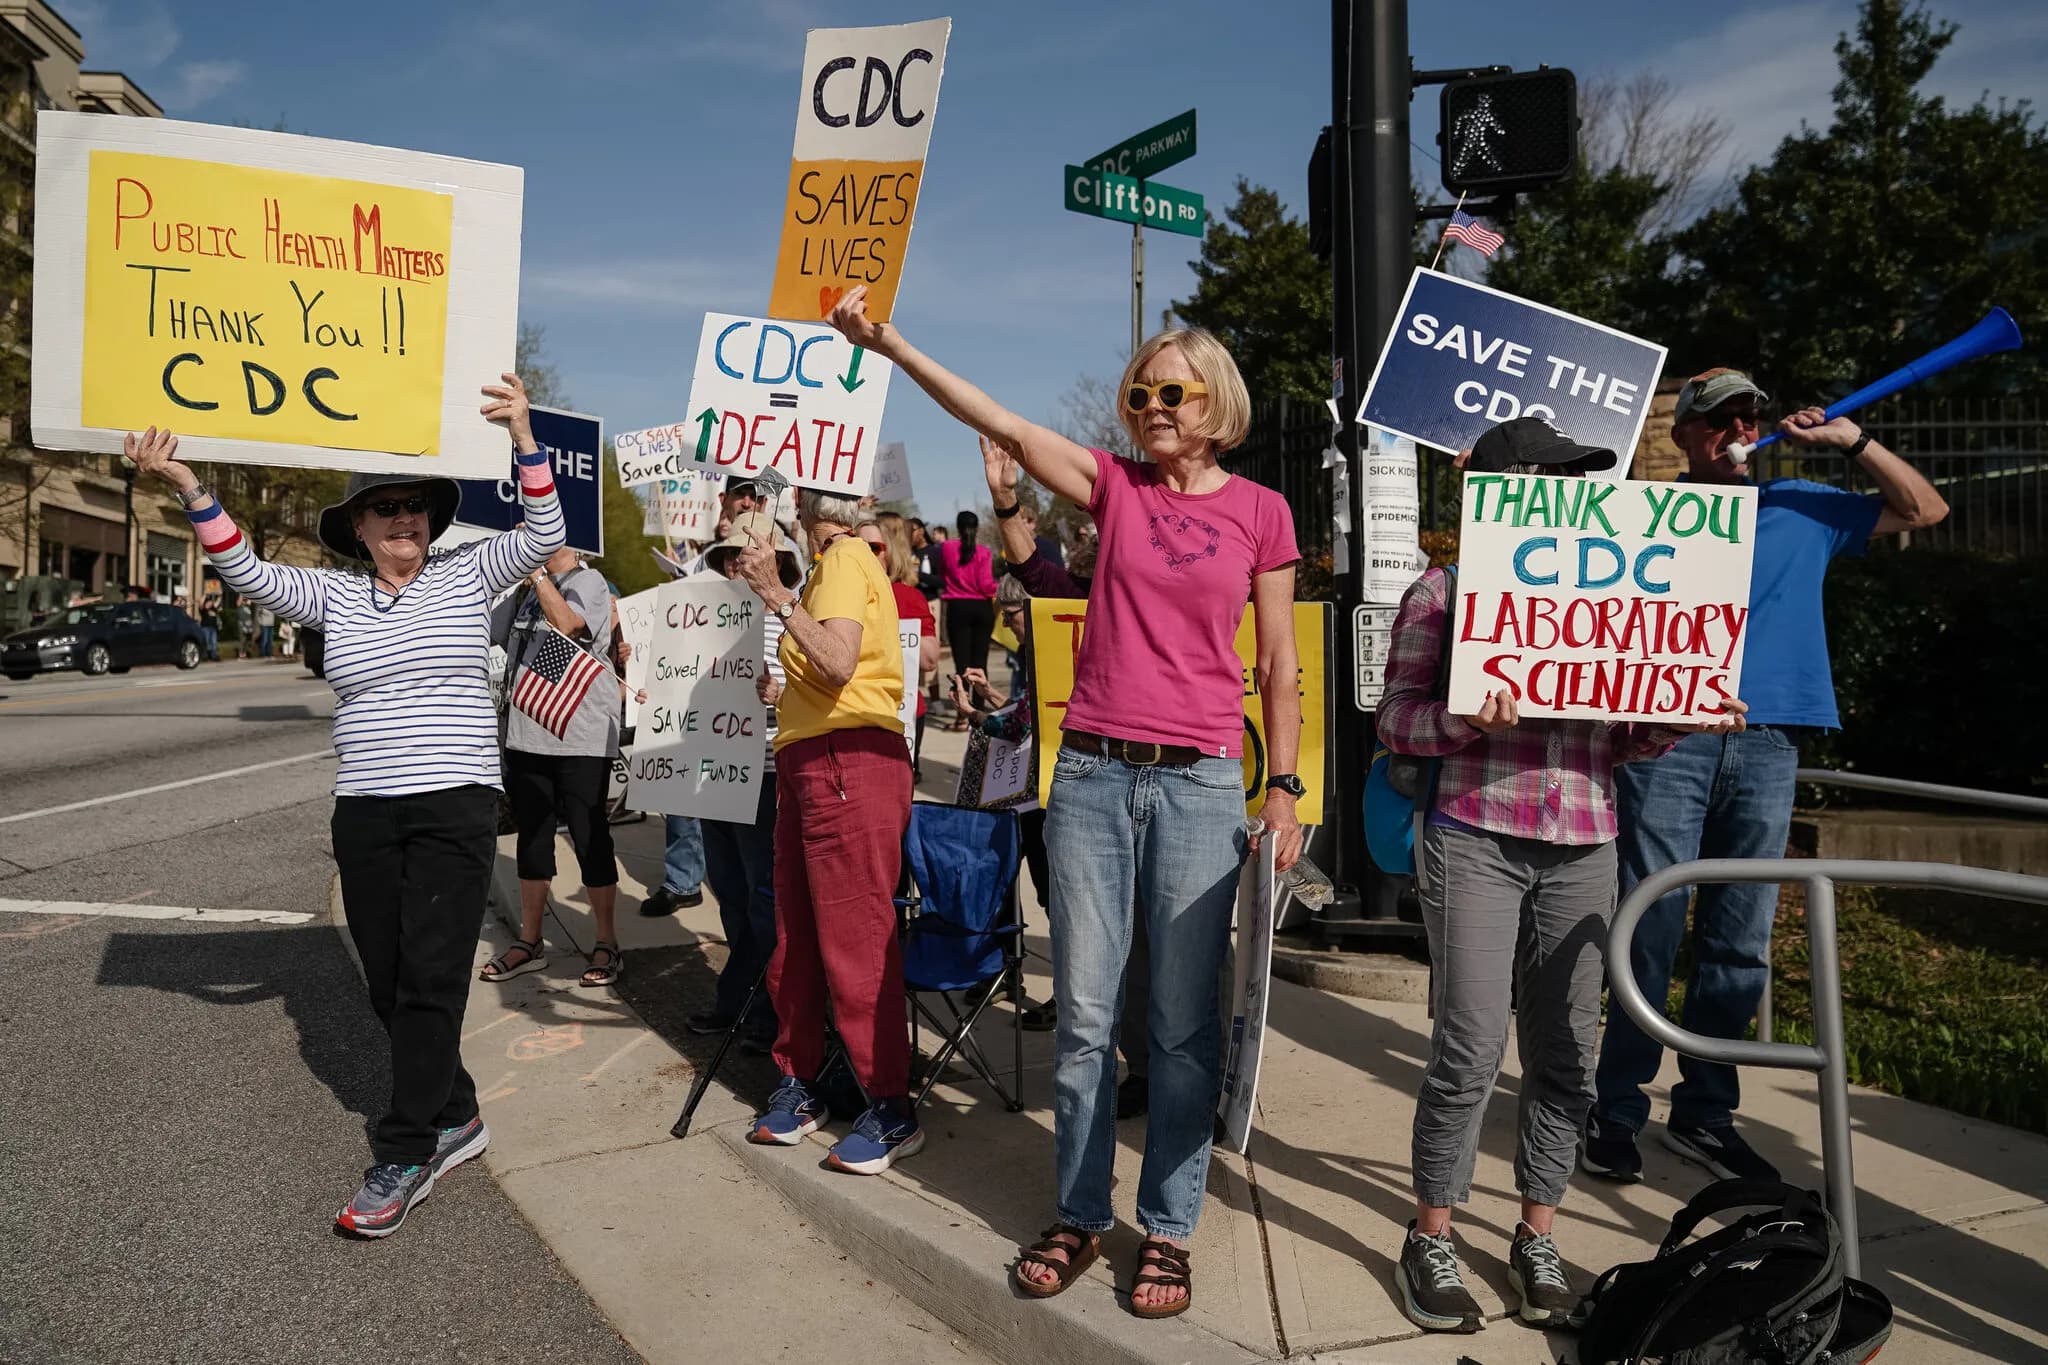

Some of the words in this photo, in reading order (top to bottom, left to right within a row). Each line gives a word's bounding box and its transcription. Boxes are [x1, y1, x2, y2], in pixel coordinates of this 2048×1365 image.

[813, 48, 934, 128] CDC
[1136, 127, 1191, 163] PARKWAY
[795, 171, 915, 226] SAVES
[1073, 176, 1173, 221] Clifton
[1178, 204, 1197, 220] RD
[801, 237, 886, 284] LIVES
[715, 321, 834, 388] CDC
[1407, 313, 1533, 378] SAVE
[1546, 355, 1640, 416] THE
[162, 352, 359, 421] CDC
[616, 432, 644, 448] CDC
[646, 424, 683, 443] SAVE
[639, 440, 673, 456] LIVES
[716, 410, 864, 485] DEATH
[622, 461, 662, 482] Save
[1369, 466, 1396, 476] SICK
[1467, 475, 1620, 537] THANK
[1642, 484, 1744, 543] YOU
[1372, 559, 1400, 569] BIRD
[1513, 536, 1676, 594] CDC
[666, 603, 709, 629] CDC
[716, 601, 752, 630] Staff
[1460, 591, 1749, 669] LABORATORY
[655, 654, 700, 681] Saved
[711, 657, 754, 681] LIVES
[1482, 654, 1732, 716] SCIENTISTS
[652, 706, 699, 734] SAVE
[712, 712, 753, 739] CDC
[635, 757, 674, 781] JOBS
[699, 758, 750, 783] FUNDS
